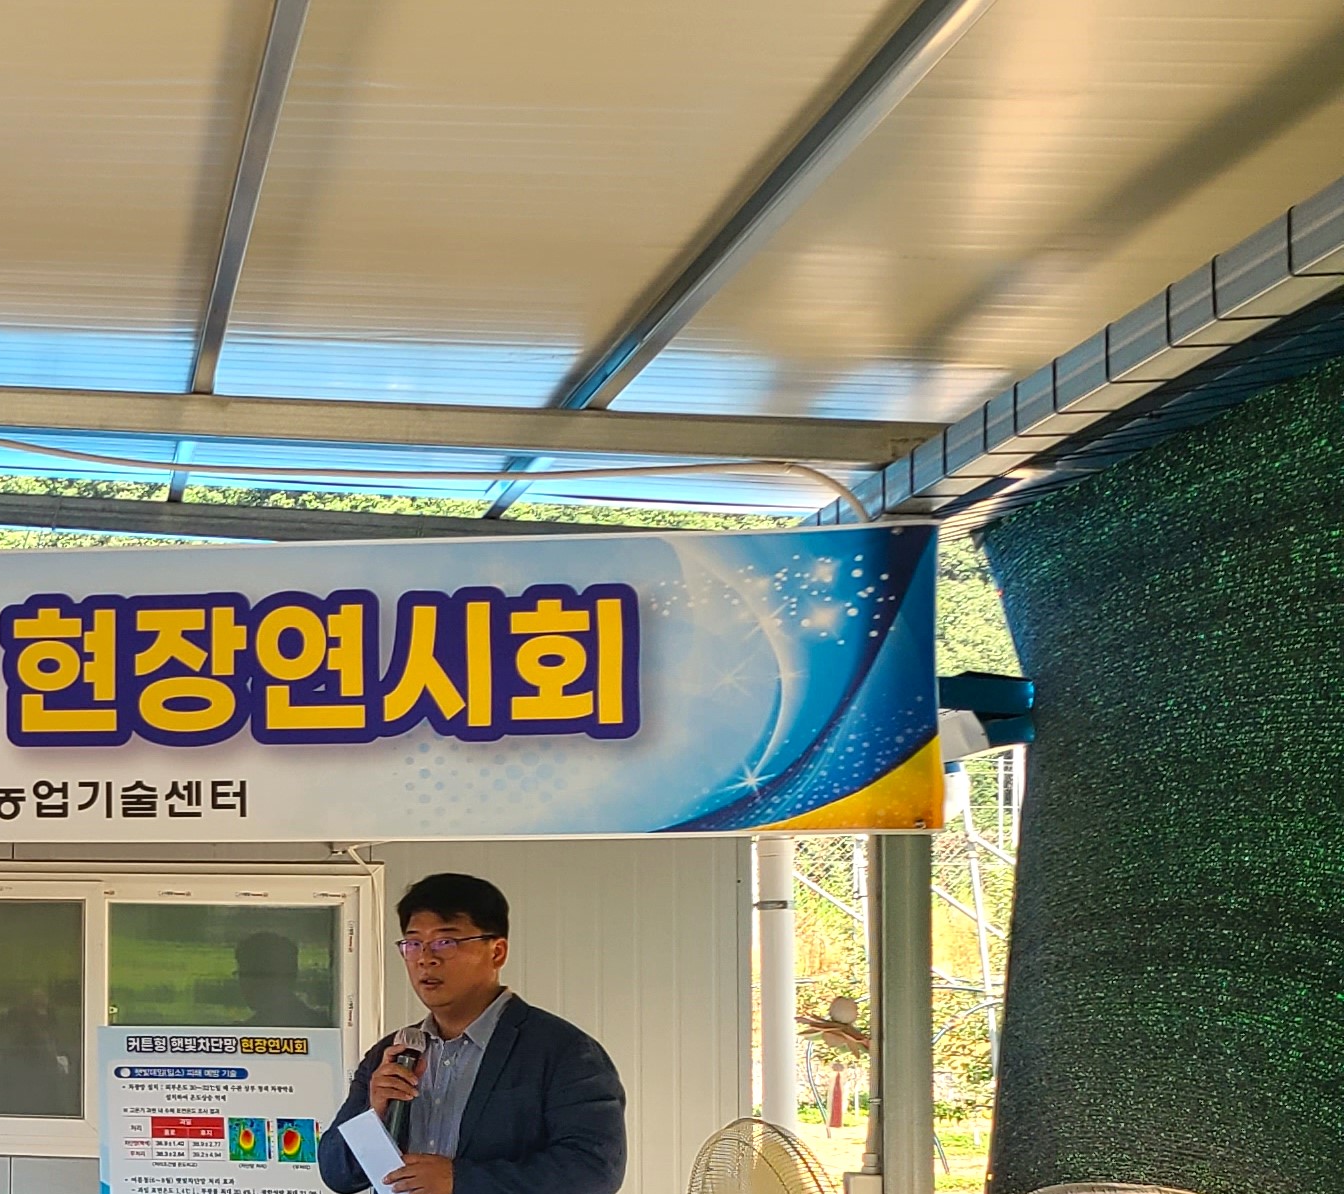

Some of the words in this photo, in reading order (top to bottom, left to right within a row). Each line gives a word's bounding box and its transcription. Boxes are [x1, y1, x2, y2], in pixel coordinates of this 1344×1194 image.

[7, 584, 641, 745] 현장연시회
[127, 1036, 167, 1052] 커튼형
[170, 1036, 237, 1053] 햇빛차단망
[240, 1038, 309, 1054] 현장연시회
[221, 1070, 237, 1078] 기술
